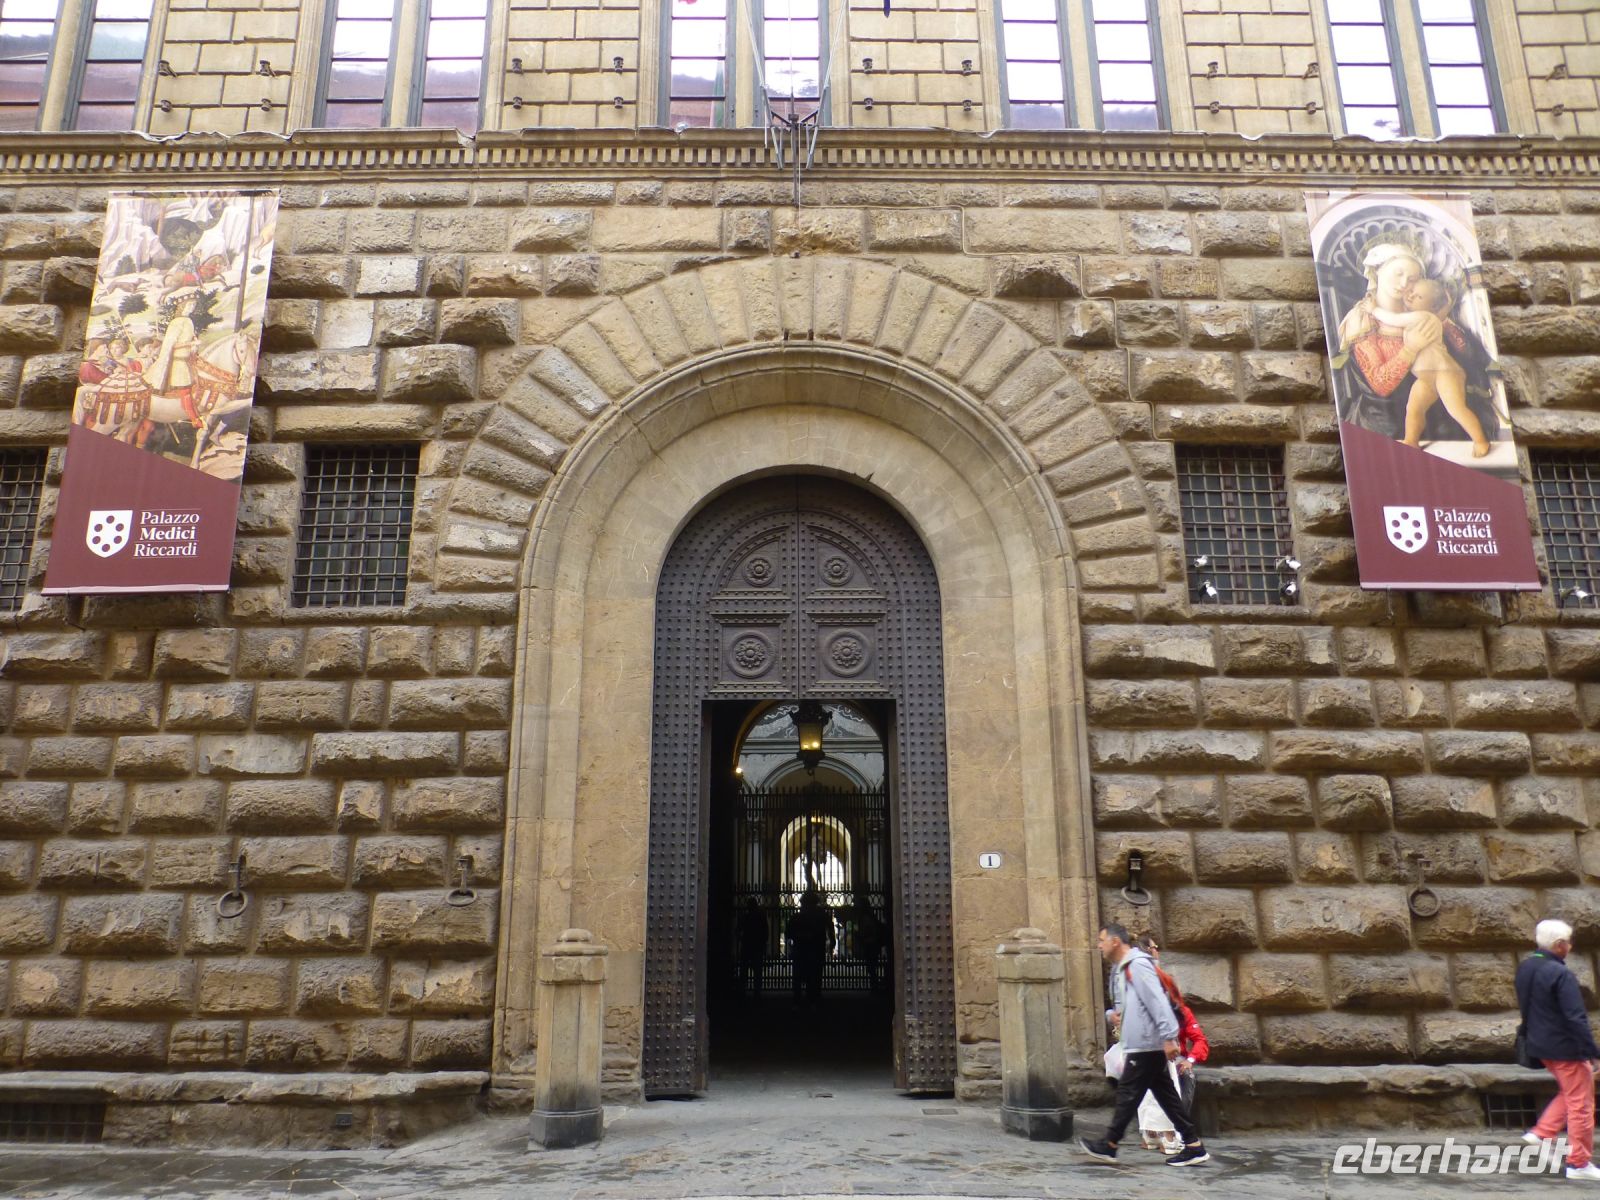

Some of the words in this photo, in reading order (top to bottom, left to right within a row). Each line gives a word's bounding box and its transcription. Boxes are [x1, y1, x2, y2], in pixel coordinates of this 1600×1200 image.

[139, 510, 200, 525] Palazzo
[1433, 508, 1491, 523] Palazzo
[139, 526, 196, 541] Medici
[1438, 524, 1492, 539] Medici
[133, 542, 197, 557] Riccardi
[1436, 540, 1498, 554] Riccardi
